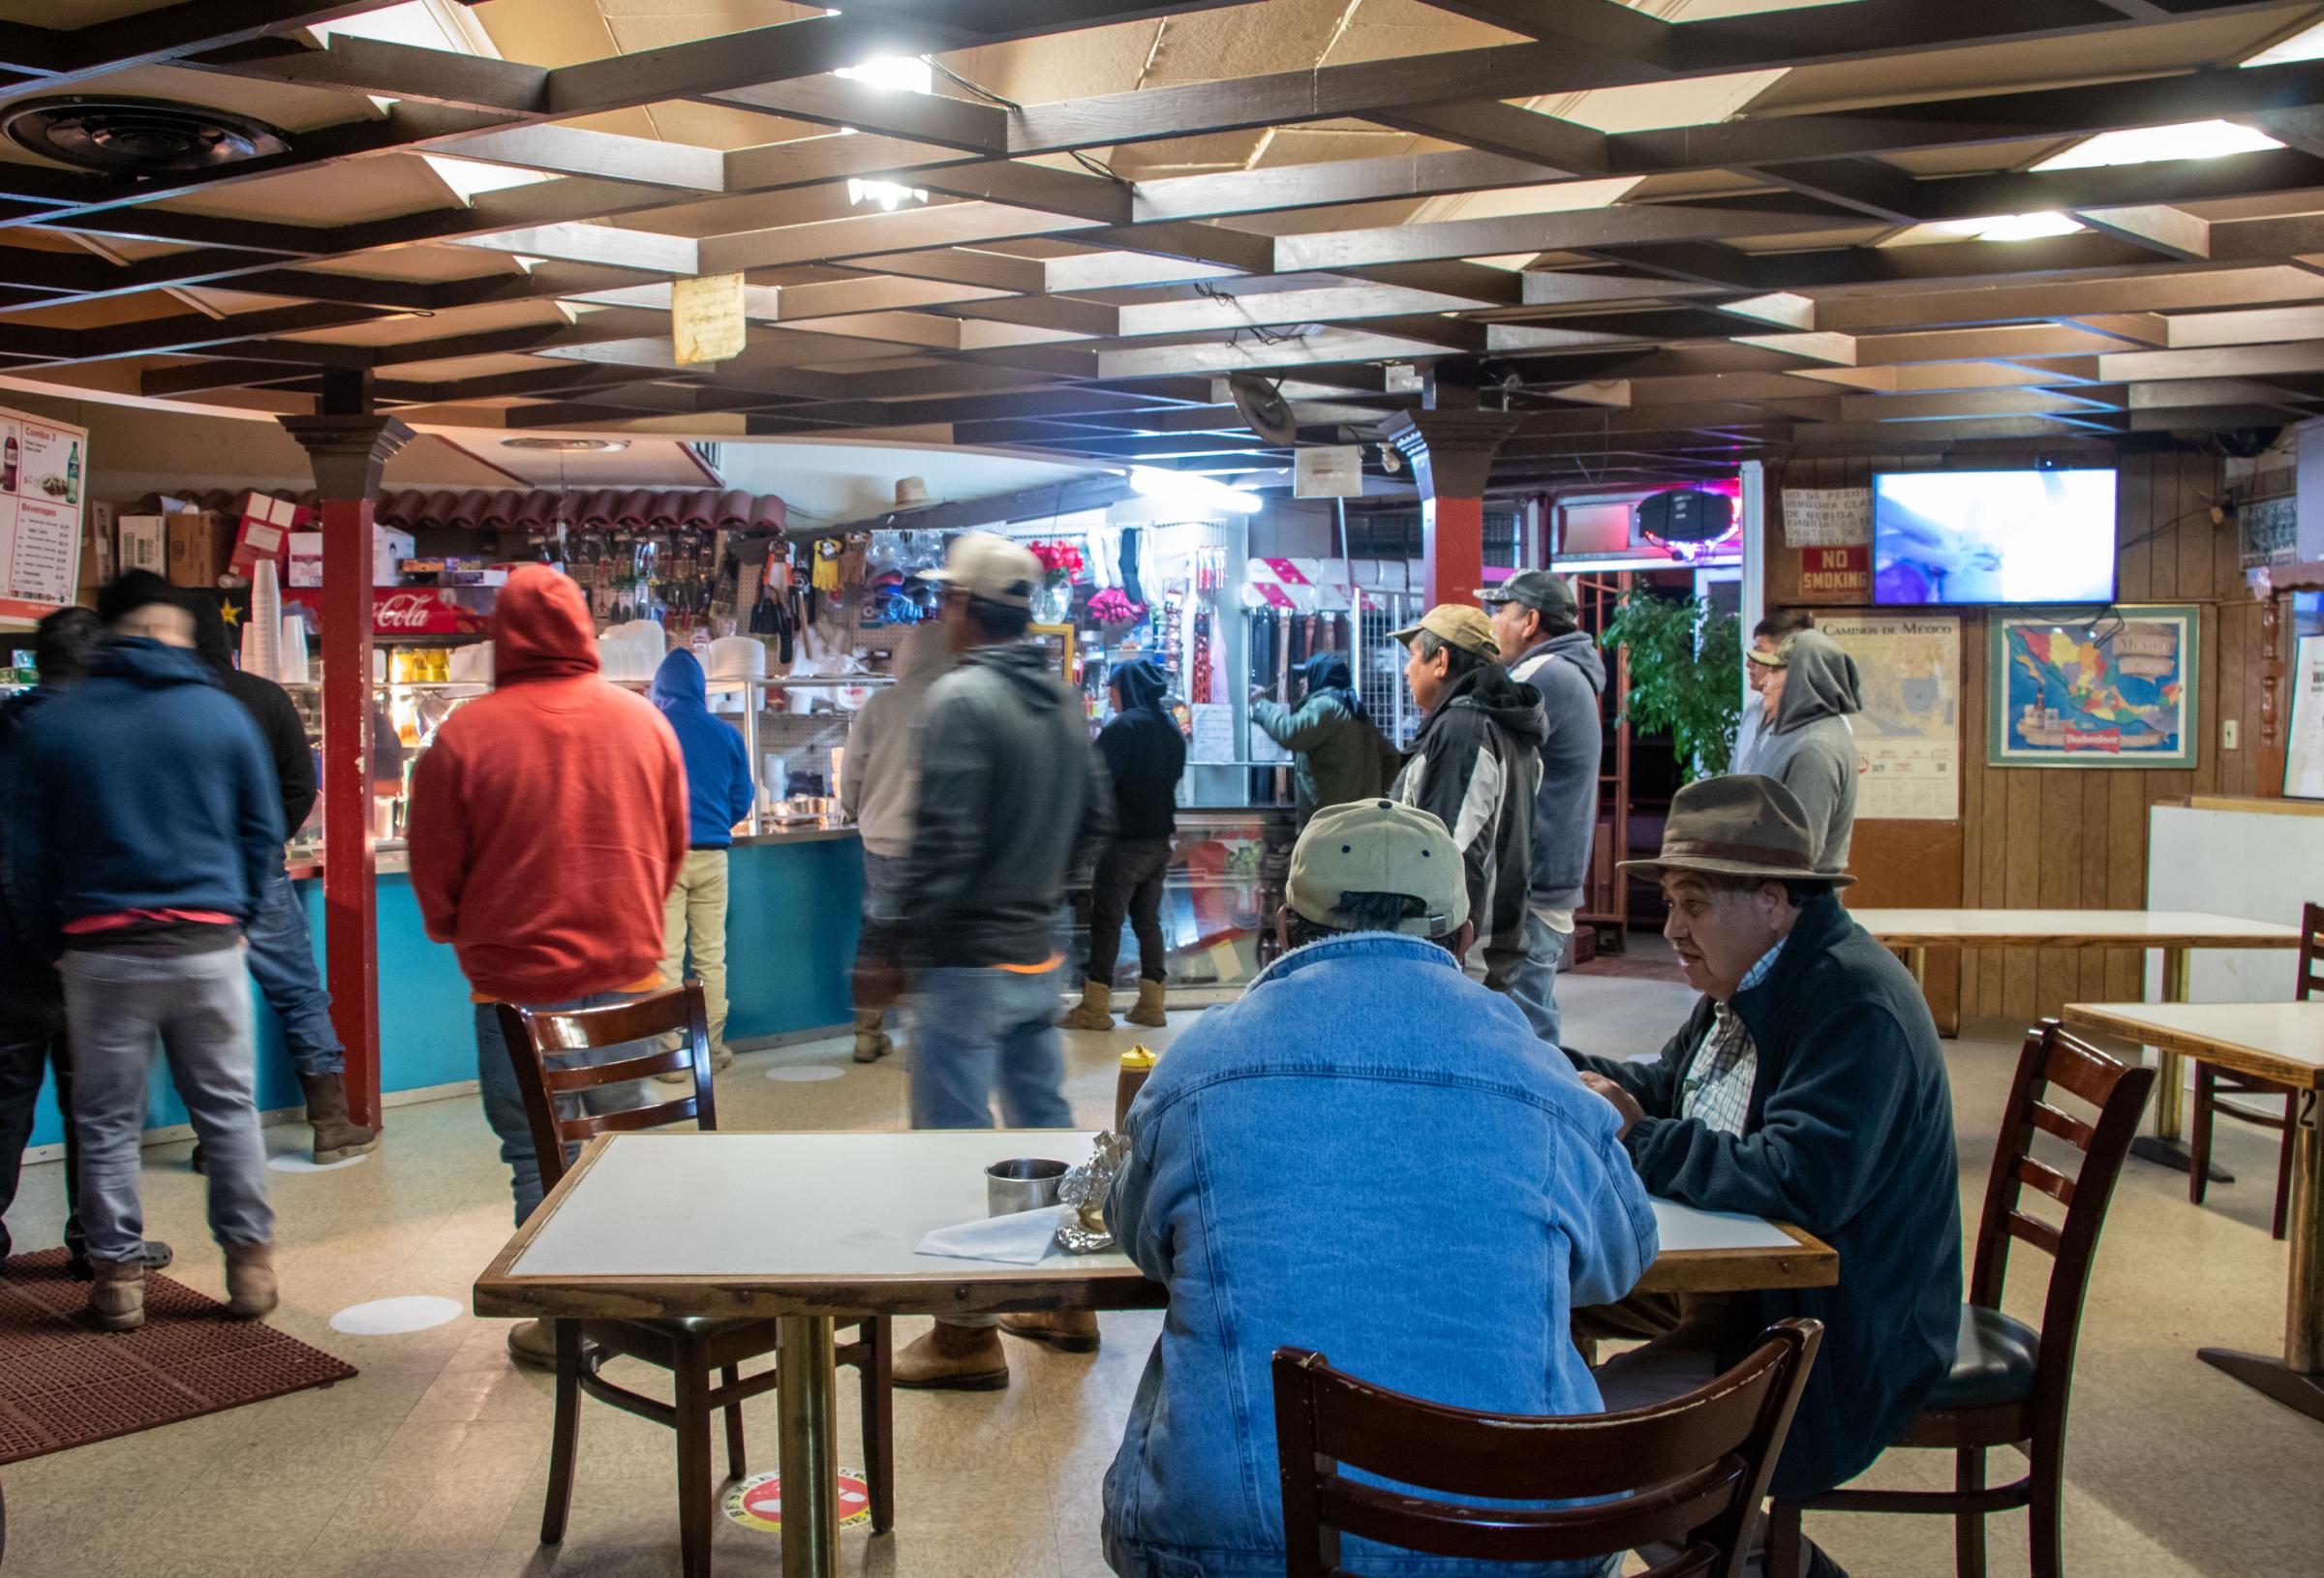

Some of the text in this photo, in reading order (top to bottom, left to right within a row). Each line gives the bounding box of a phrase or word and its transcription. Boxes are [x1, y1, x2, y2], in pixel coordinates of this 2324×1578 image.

[25, 427, 50, 440] Combo
[21, 502, 56, 517] Beverages
[1821, 549, 1849, 569] NO
[1803, 571, 1868, 590] SMOKING
[2065, 733, 2119, 745] Budweiser
